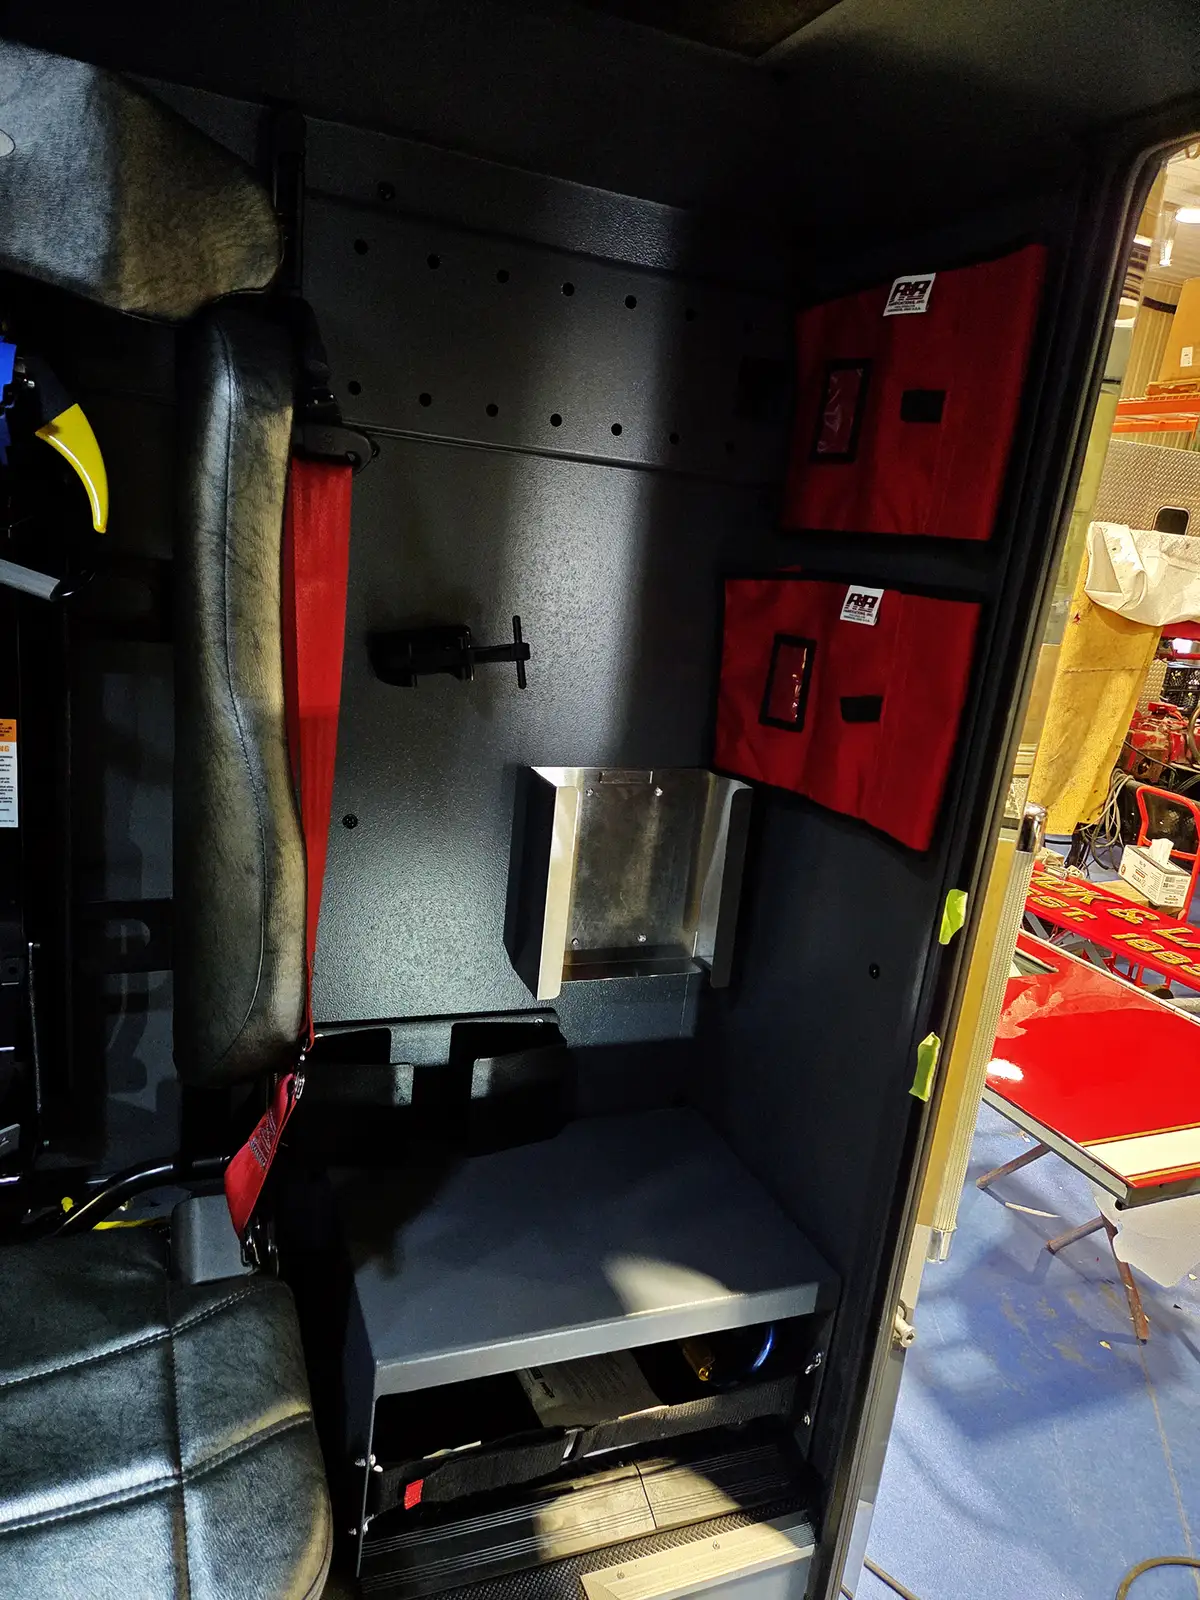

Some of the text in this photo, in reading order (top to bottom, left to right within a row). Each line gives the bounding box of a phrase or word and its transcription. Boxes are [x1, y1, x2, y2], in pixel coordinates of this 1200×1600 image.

[890, 280, 931, 300] R&R
[847, 593, 878, 608] R&R
[1106, 908, 1160, 925] &
